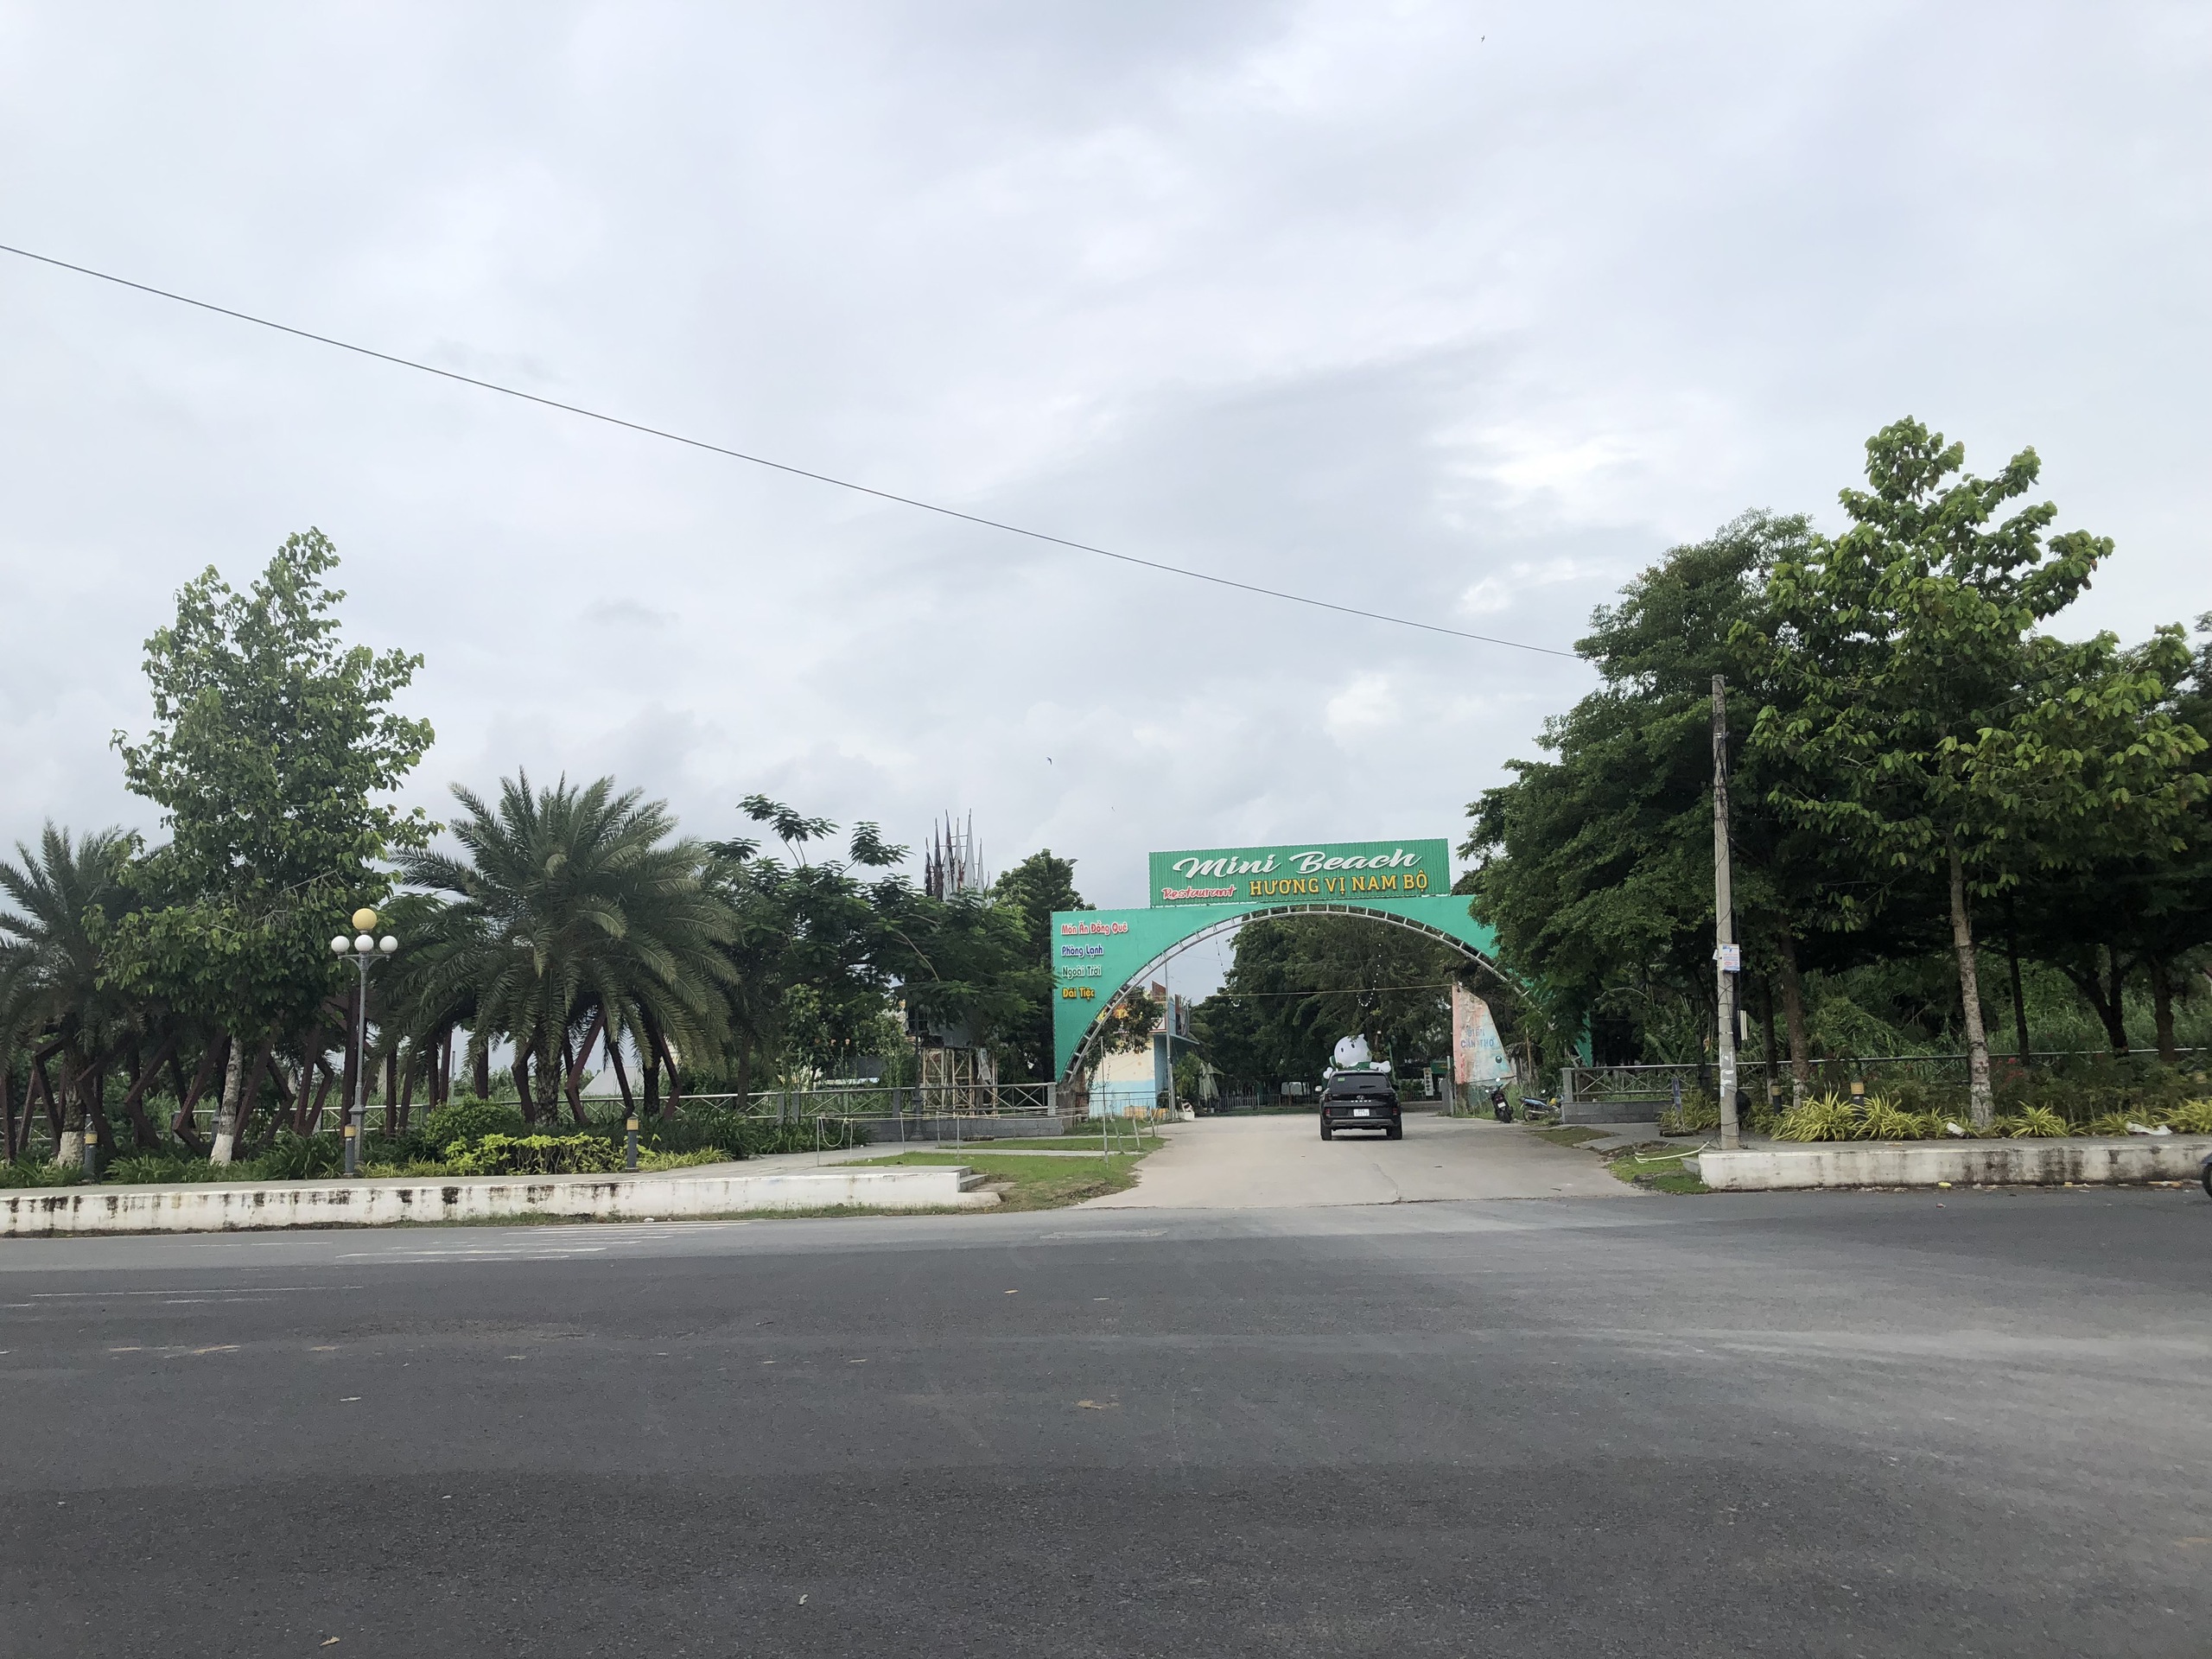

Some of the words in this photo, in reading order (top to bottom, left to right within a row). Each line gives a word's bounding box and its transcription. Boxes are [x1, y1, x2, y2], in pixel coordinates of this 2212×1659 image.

[1173, 854, 1281, 879] Mini
[1288, 849, 1422, 874] Beach
[1249, 878, 1319, 896] HƯƠNG
[1325, 876, 1345, 895] VỊ
[1351, 874, 1396, 892] NAM
[1403, 869, 1428, 893] BỘ
[1161, 884, 1236, 899] Restaurant
[1061, 922, 1077, 935] Món
[1078, 920, 1089, 934] Ăn
[1090, 920, 1110, 936] Đồng
[1111, 921, 1128, 933] Quê
[1061, 944, 1084, 958] Phòng
[1085, 944, 1103, 958] Lạnh
[1062, 965, 1085, 979] Ngoài
[1086, 964, 1102, 976] Trời
[1062, 987, 1077, 998] Đãi
[1079, 986, 1096, 1001] Tiệc
